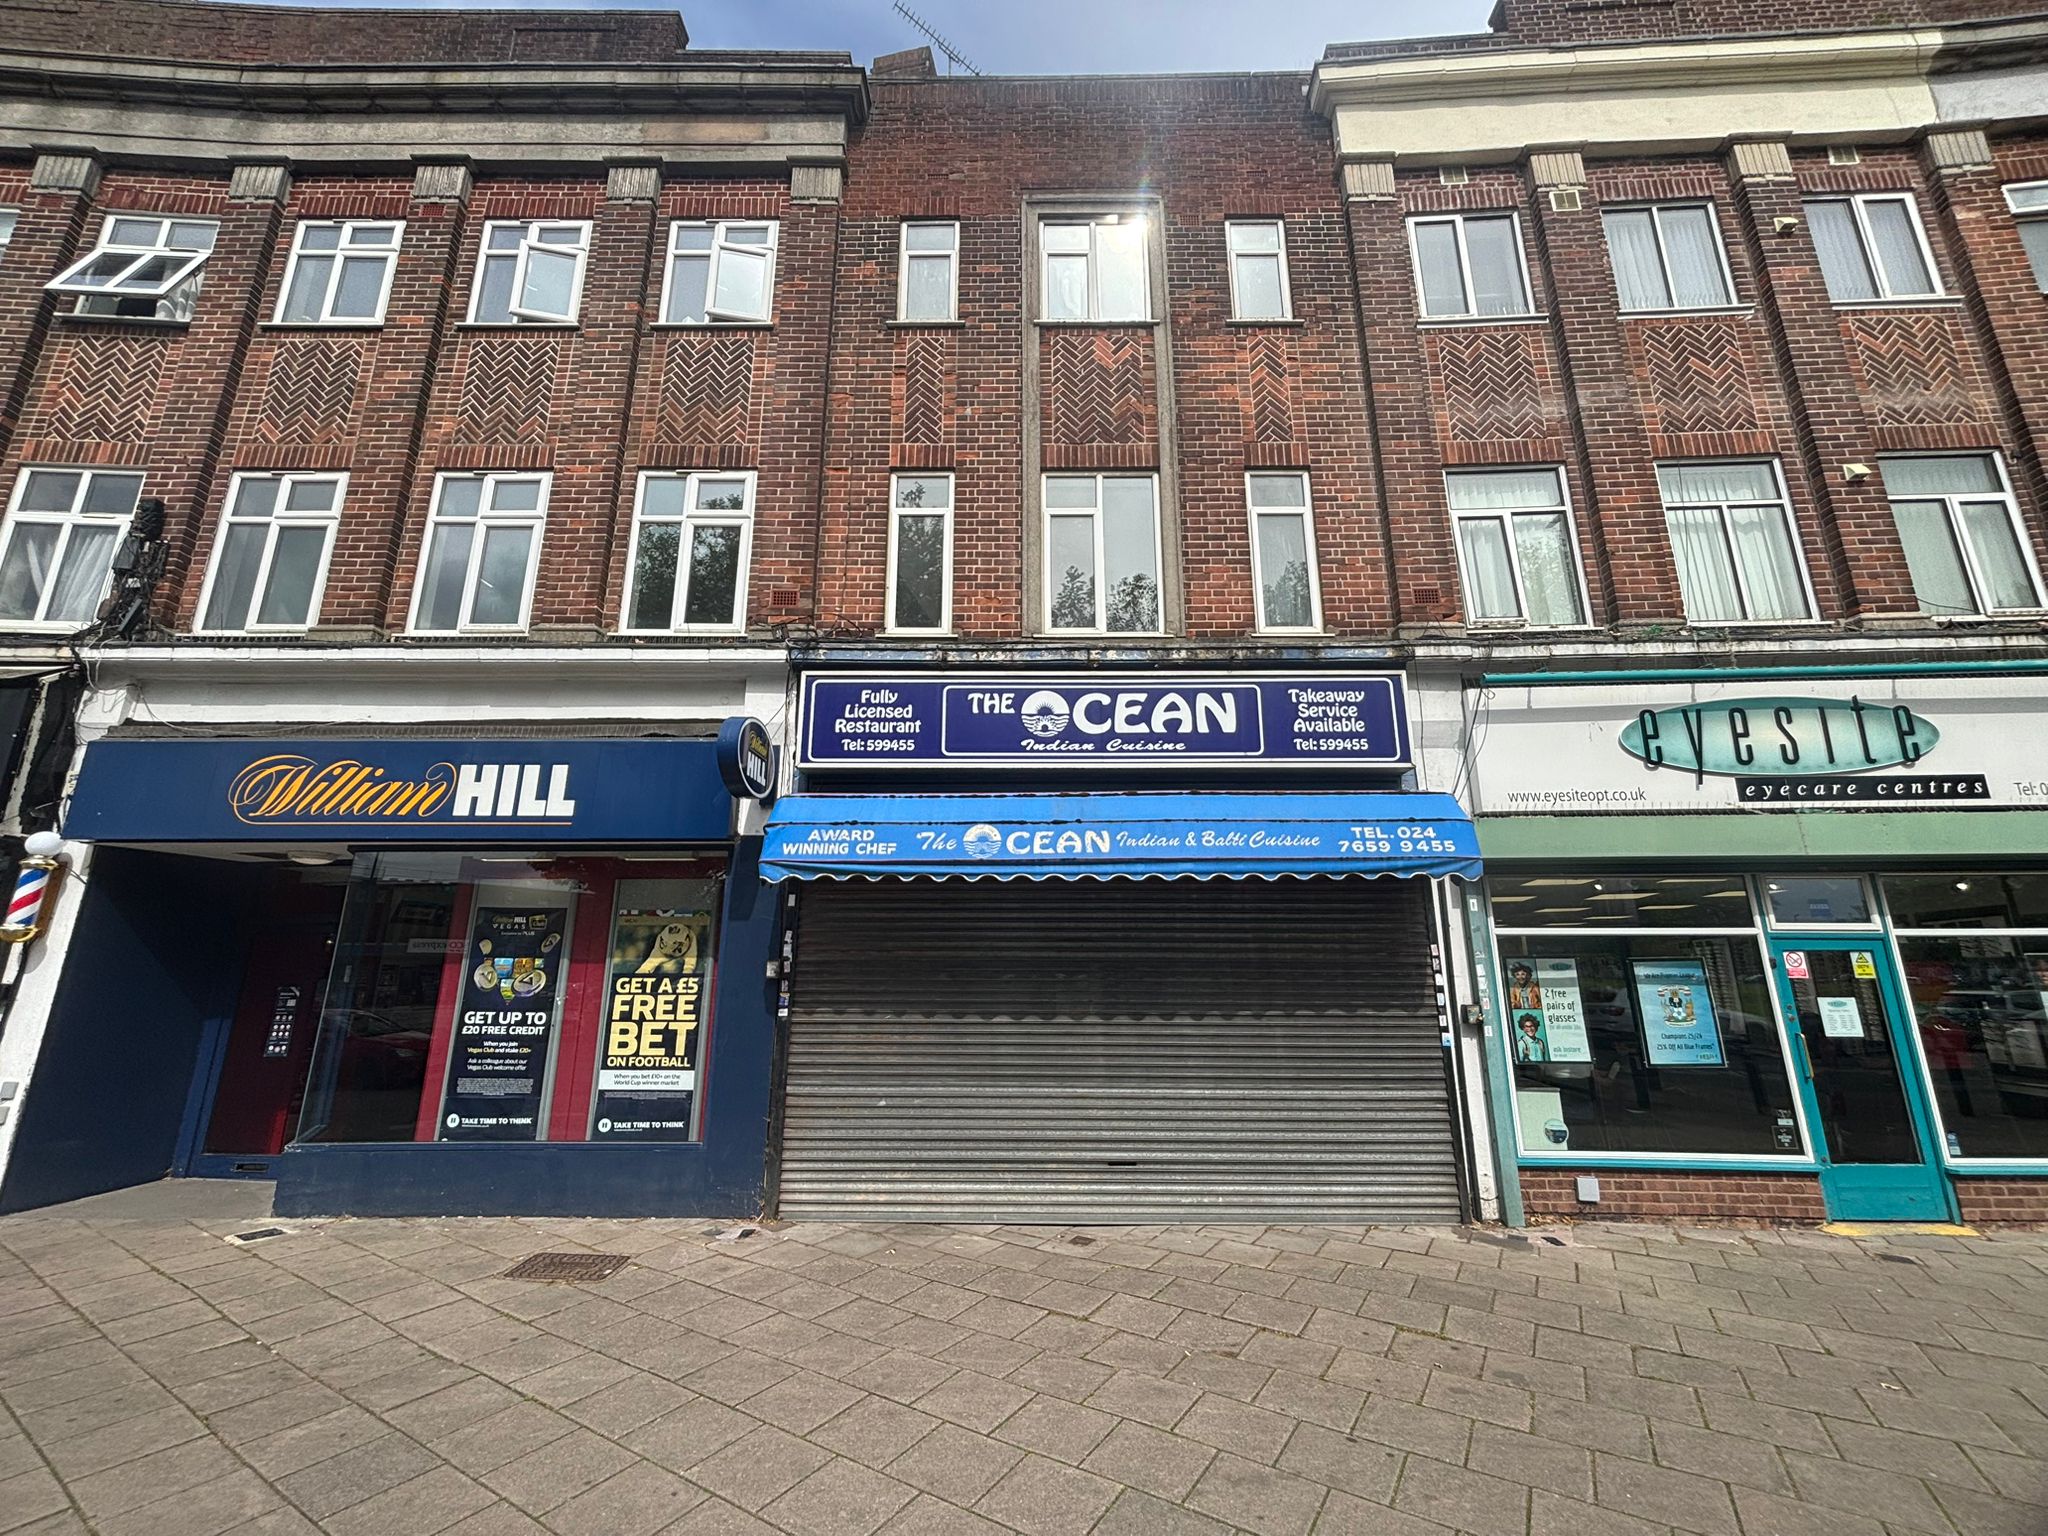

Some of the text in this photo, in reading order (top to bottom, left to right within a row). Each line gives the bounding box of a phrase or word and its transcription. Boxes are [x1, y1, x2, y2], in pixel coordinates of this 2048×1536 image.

[861, 689, 898, 704] Fully
[1287, 688, 1365, 703] Takeaway
[967, 692, 1016, 714] THE
[844, 704, 913, 718] Licensed
[1298, 703, 1358, 718] Service
[835, 719, 922, 733] Restaurant
[1293, 718, 1365, 733] Available
[1020, 739, 1186, 751] Indian Cuisine
[1639, 695, 1921, 785] eyesite
[746, 751, 766, 787] HILL
[228, 754, 575, 817] William HILL
[1745, 780, 1983, 799] eyecare centres
[1507, 786, 1647, 805] www.eyesiteopt.co.uk
[807, 829, 875, 841] AWARD
[1350, 826, 1437, 839] TEL. 024
[915, 831, 958, 850] The
[1115, 831, 1180, 848] Indian
[1184, 832, 1197, 846] &
[1201, 830, 1247, 847] Balti
[1249, 831, 1321, 848] Cuisine
[1338, 840, 1456, 852] 7659 9455
[782, 843, 897, 855] WINNING CHEF
[616, 977, 699, 993] GET A £5
[1544, 988, 1567, 1000] 2 free
[612, 994, 698, 1021] FREE
[1546, 1001, 1575, 1012] pairs of
[464, 1011, 547, 1025] GET UP TO
[1548, 1014, 1577, 1024] glasses
[461, 1025, 545, 1035] £20 FREE CREDIT
[607, 1021, 698, 1056] BET
[607, 1056, 691, 1068] ON FOOTBALL
[613, 1121, 631, 1129] TAKE
